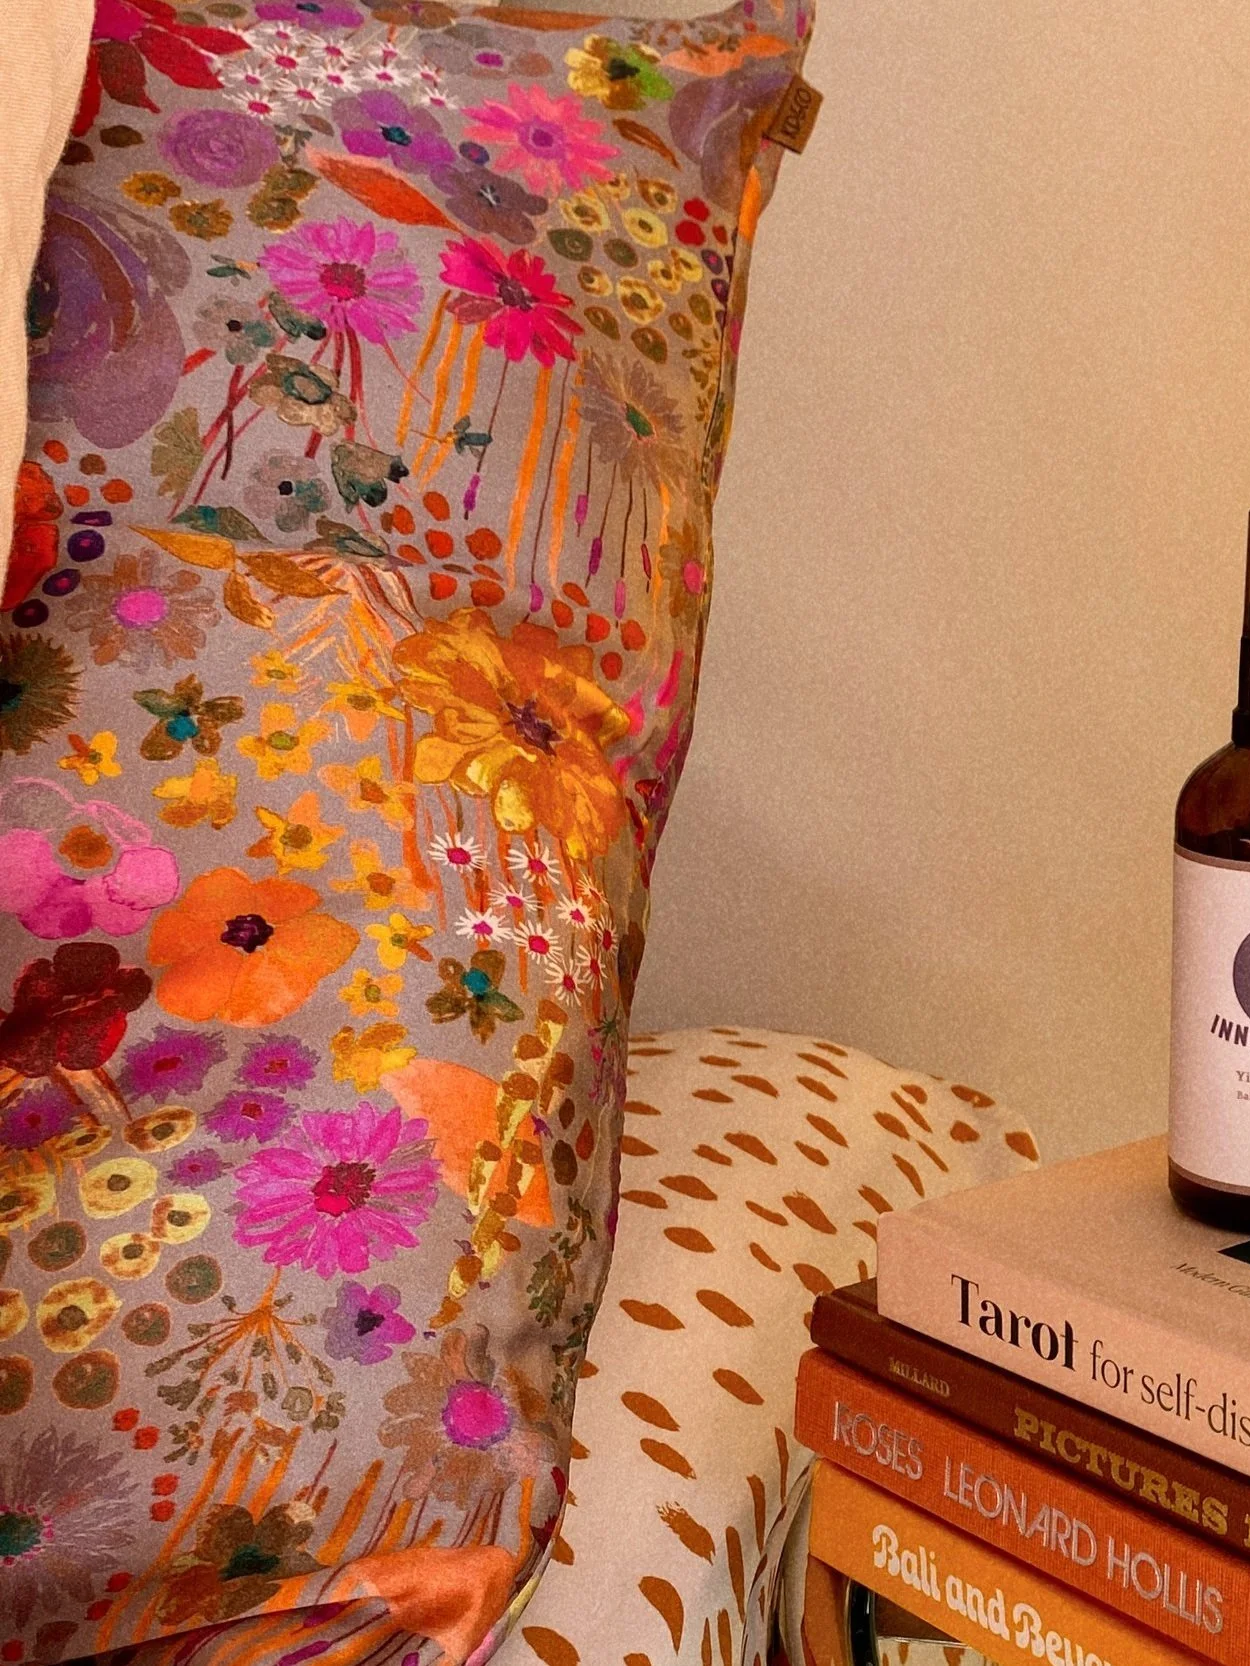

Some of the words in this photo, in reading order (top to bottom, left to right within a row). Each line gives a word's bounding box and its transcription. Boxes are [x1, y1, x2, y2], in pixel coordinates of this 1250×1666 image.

[949, 1273, 1080, 1373] Tarot
[1089, 1338, 1137, 1394] for
[1171, 1262, 1232, 1294] Modern
[888, 1356, 951, 1399] MILLARD
[831, 1400, 925, 1482] ROSES
[942, 1454, 1098, 1569] LEONARD
[1106, 1534, 1226, 1636] HOLLIS
[1012, 1406, 1230, 1537] PICTURES
[871, 1523, 941, 1603] Bali
[945, 1573, 1011, 1642] and
